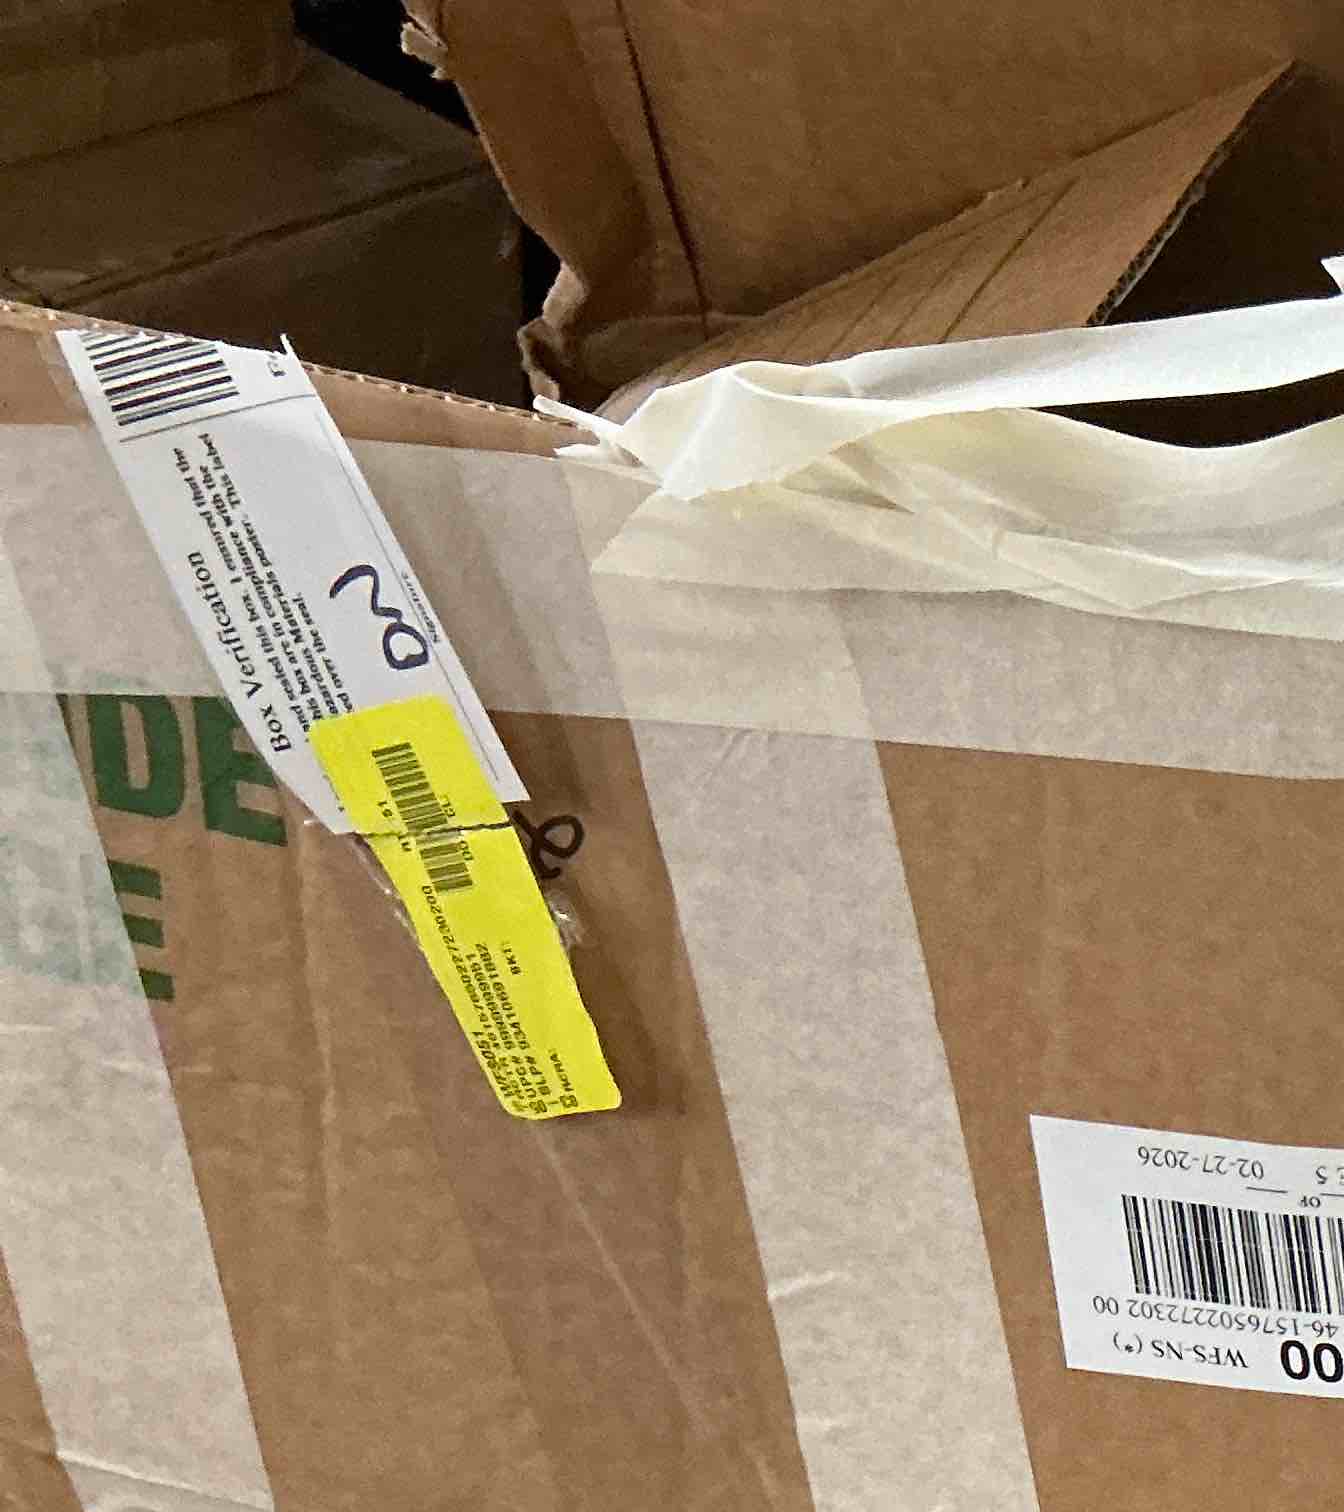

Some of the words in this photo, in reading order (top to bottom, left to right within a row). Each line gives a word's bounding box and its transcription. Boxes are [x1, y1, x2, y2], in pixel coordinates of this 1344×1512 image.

[168, 445, 190, 474] the
[197, 429, 225, 472] label
[181, 473, 207, 509] that
[195, 461, 217, 489] the
[216, 472, 241, 509] This
[207, 489, 235, 530] with
[200, 509, 237, 574] ensured
[225, 527, 279, 621] compliance
[182, 547, 266, 701] Verification
[262, 567, 307, 646] Materials
[251, 624, 274, 656] this
[277, 638, 299, 667] are
[306, 627, 326, 653] the
[266, 654, 297, 704] sealed
[290, 666, 312, 696] box
[297, 645, 340, 718] azardous
[320, 653, 344, 690] over
[255, 700, 293, 755] Box
[1135, 1145, 1265, 1181] 02-27-2026
[1091, 1294, 1119, 1316] 00
[1124, 1300, 1338, 1339] 46-1576502272302
[1149, 1338, 1248, 1367] WFS-NS
[1277, 1338, 1344, 1383] 00
